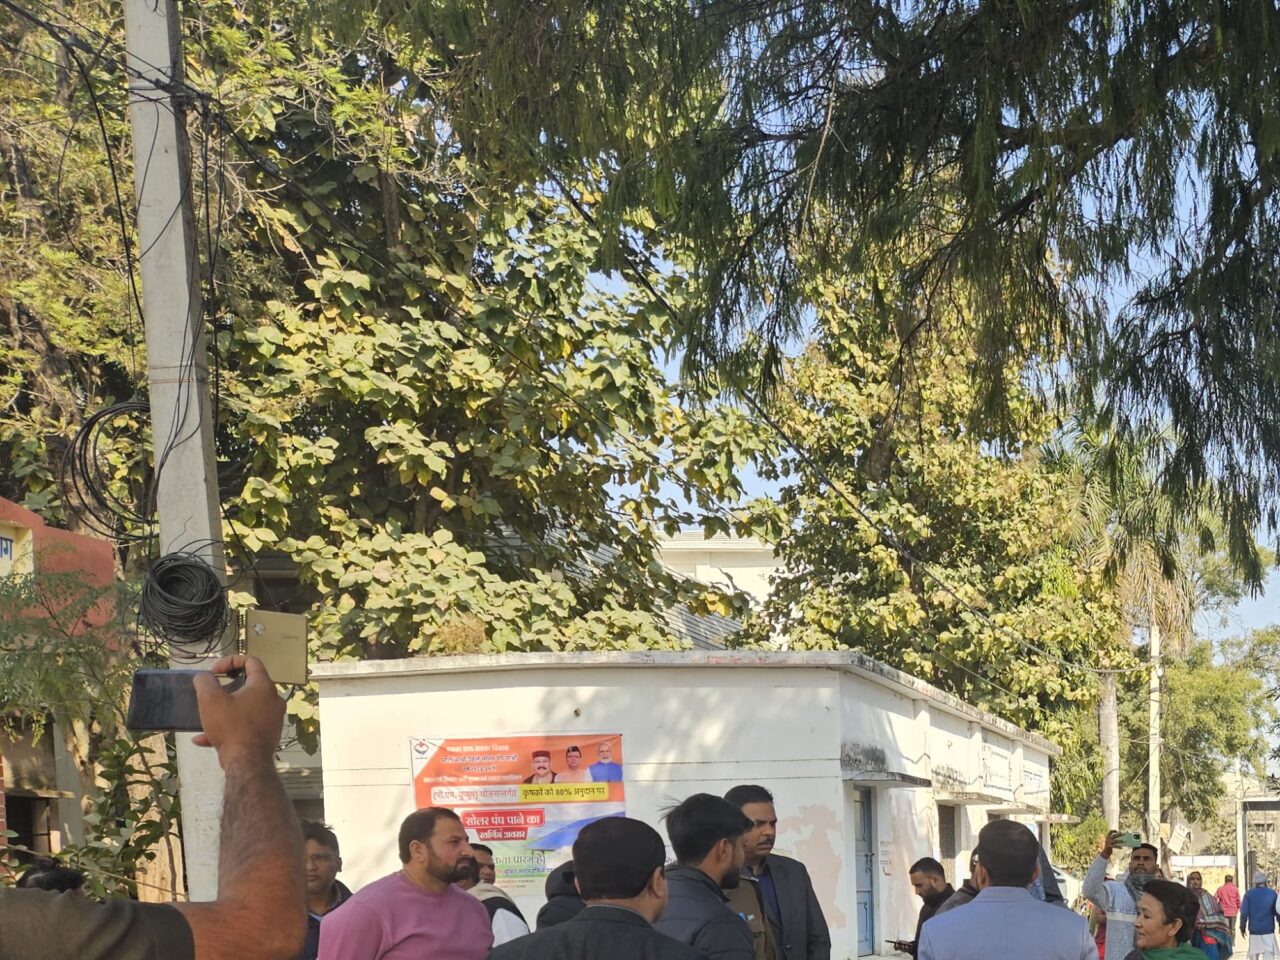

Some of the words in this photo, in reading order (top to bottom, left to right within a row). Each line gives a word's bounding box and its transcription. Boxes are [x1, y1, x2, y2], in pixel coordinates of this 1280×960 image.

[522, 788, 543, 799] कृषकों
[545, 787, 554, 796] को
[555, 788, 572, 796] 80%
[574, 787, 595, 798] अनुदान
[597, 786, 605, 795] पर
[465, 813, 489, 826] सोलर
[491, 814, 505, 825] पंप
[507, 812, 524, 825] पाने
[527, 815, 540, 824] का
[503, 830, 526, 839] अवसर
